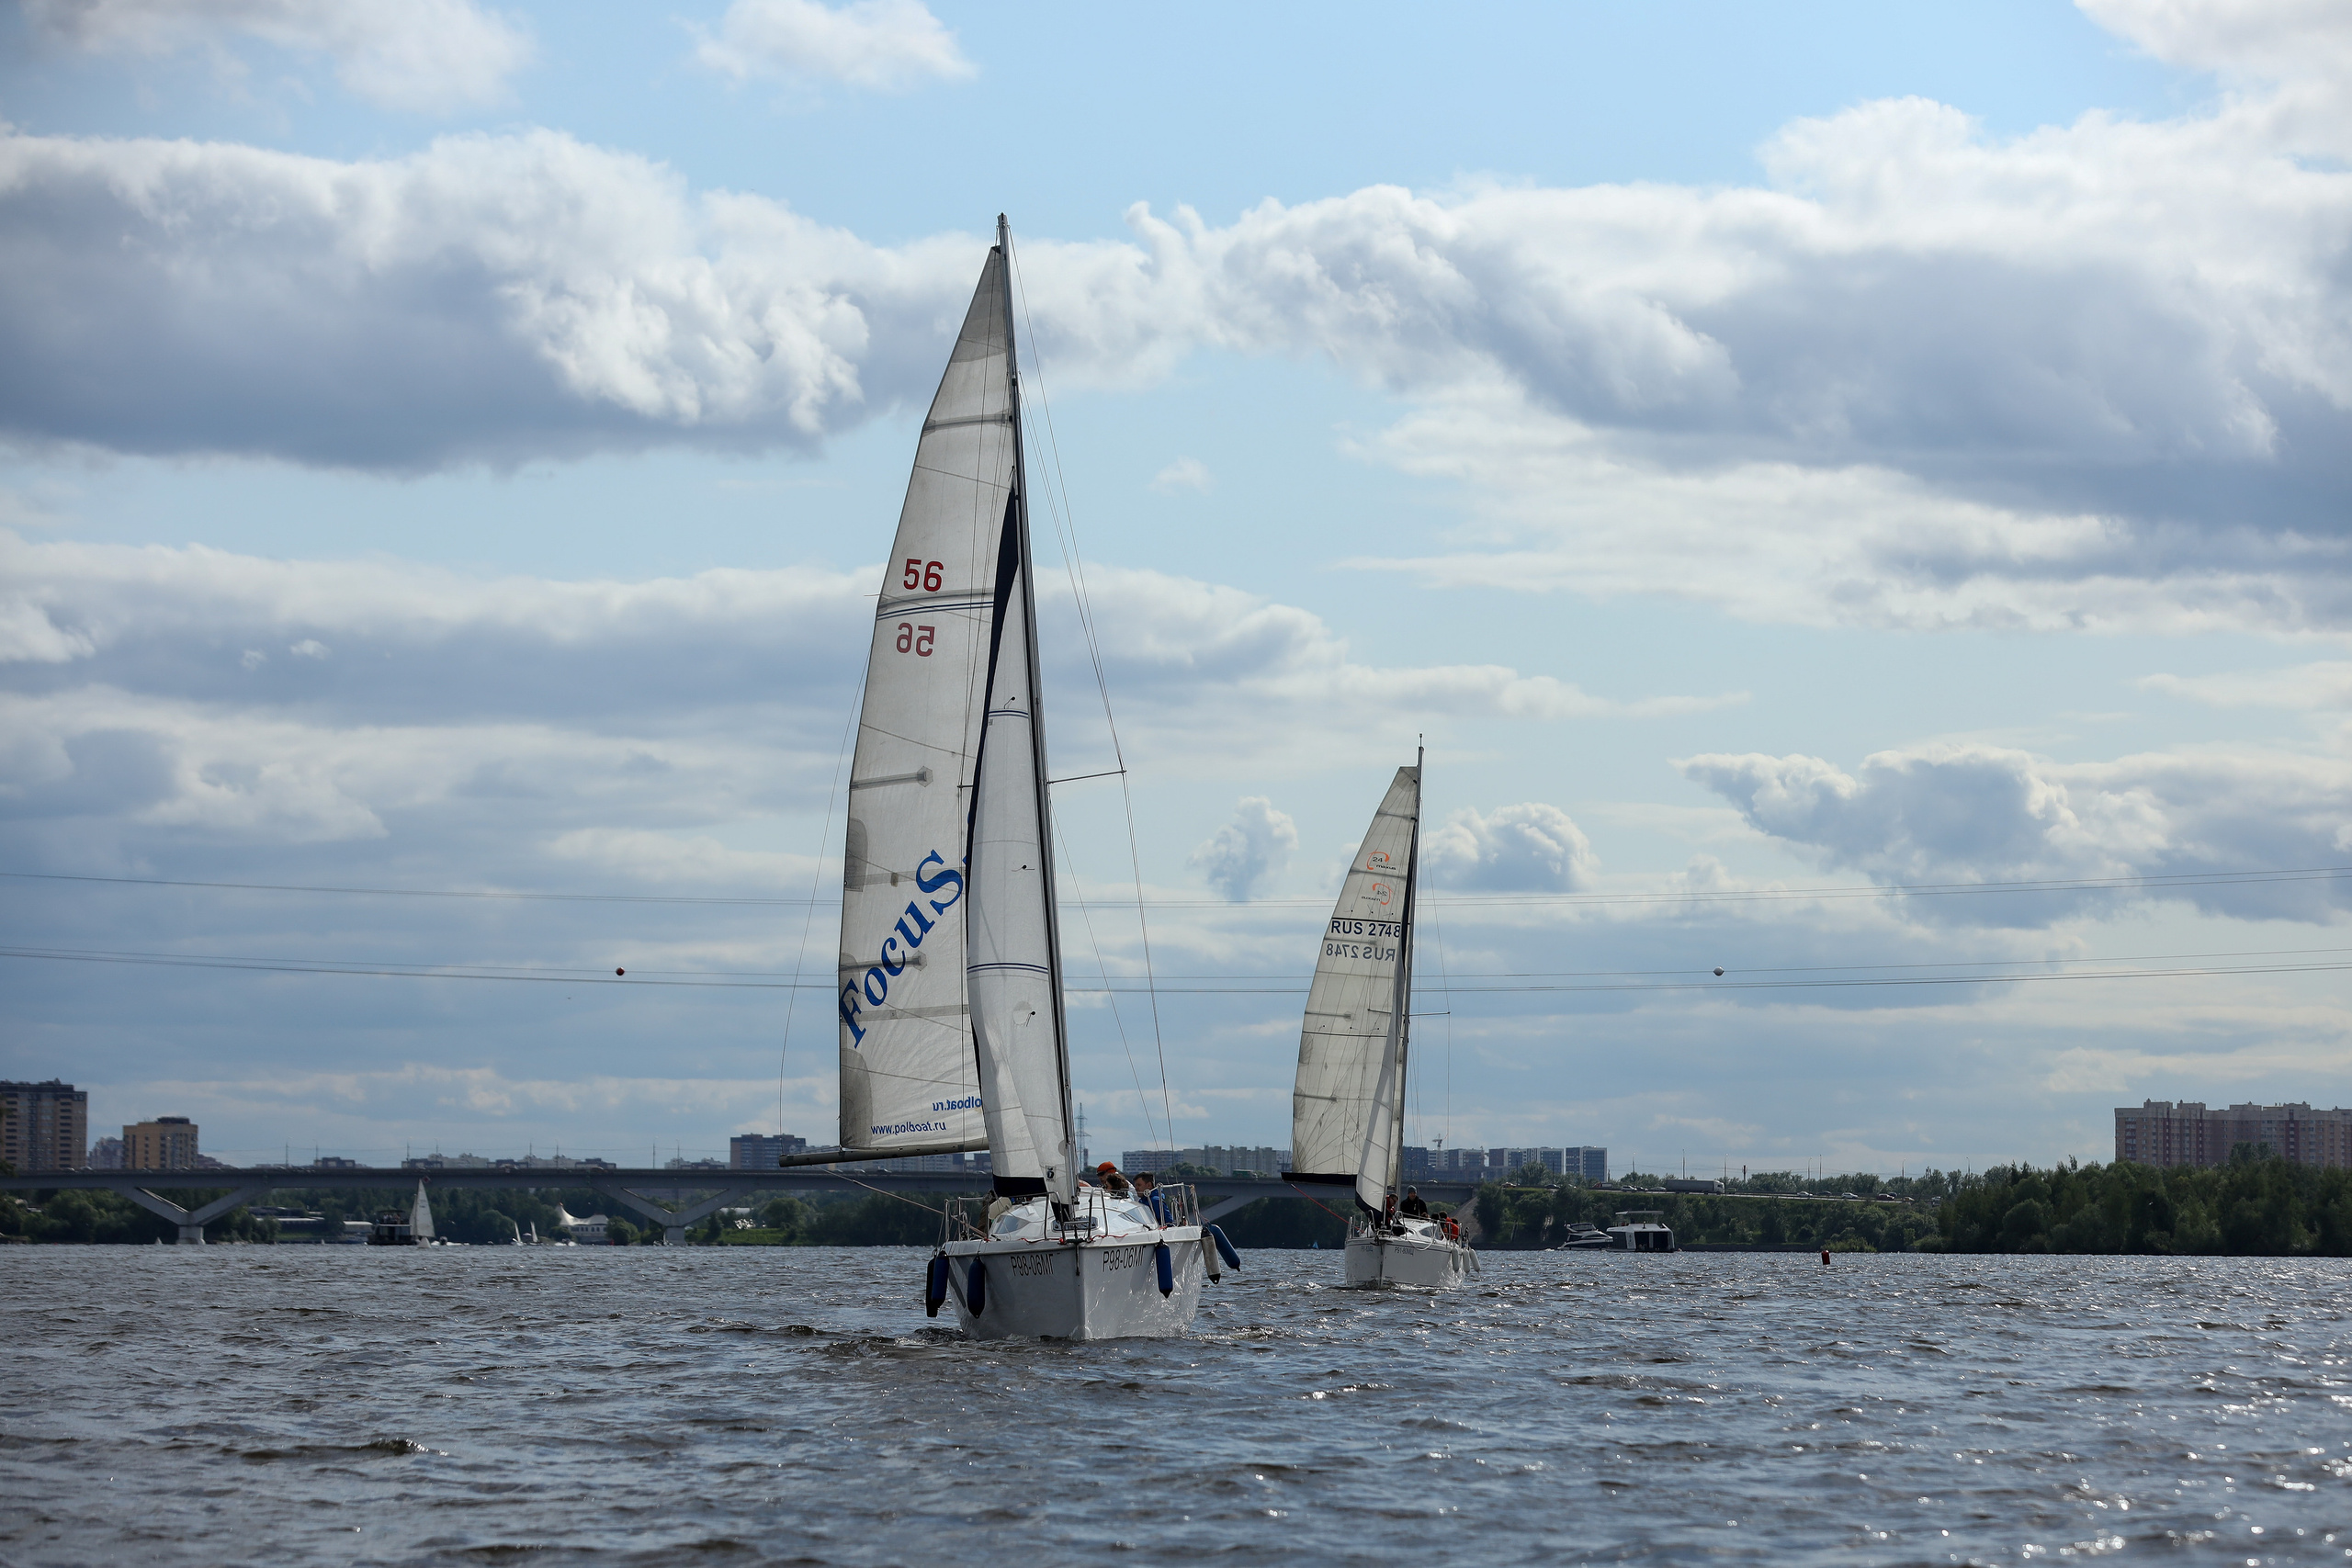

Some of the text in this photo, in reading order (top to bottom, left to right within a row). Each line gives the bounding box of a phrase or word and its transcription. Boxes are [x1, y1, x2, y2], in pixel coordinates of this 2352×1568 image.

[903, 558, 944, 592] 56
[1331, 920, 1400, 938] RUS 2748
[839, 849, 964, 1049] FocuS
[870, 1121, 946, 1135] www.polboat.ru
